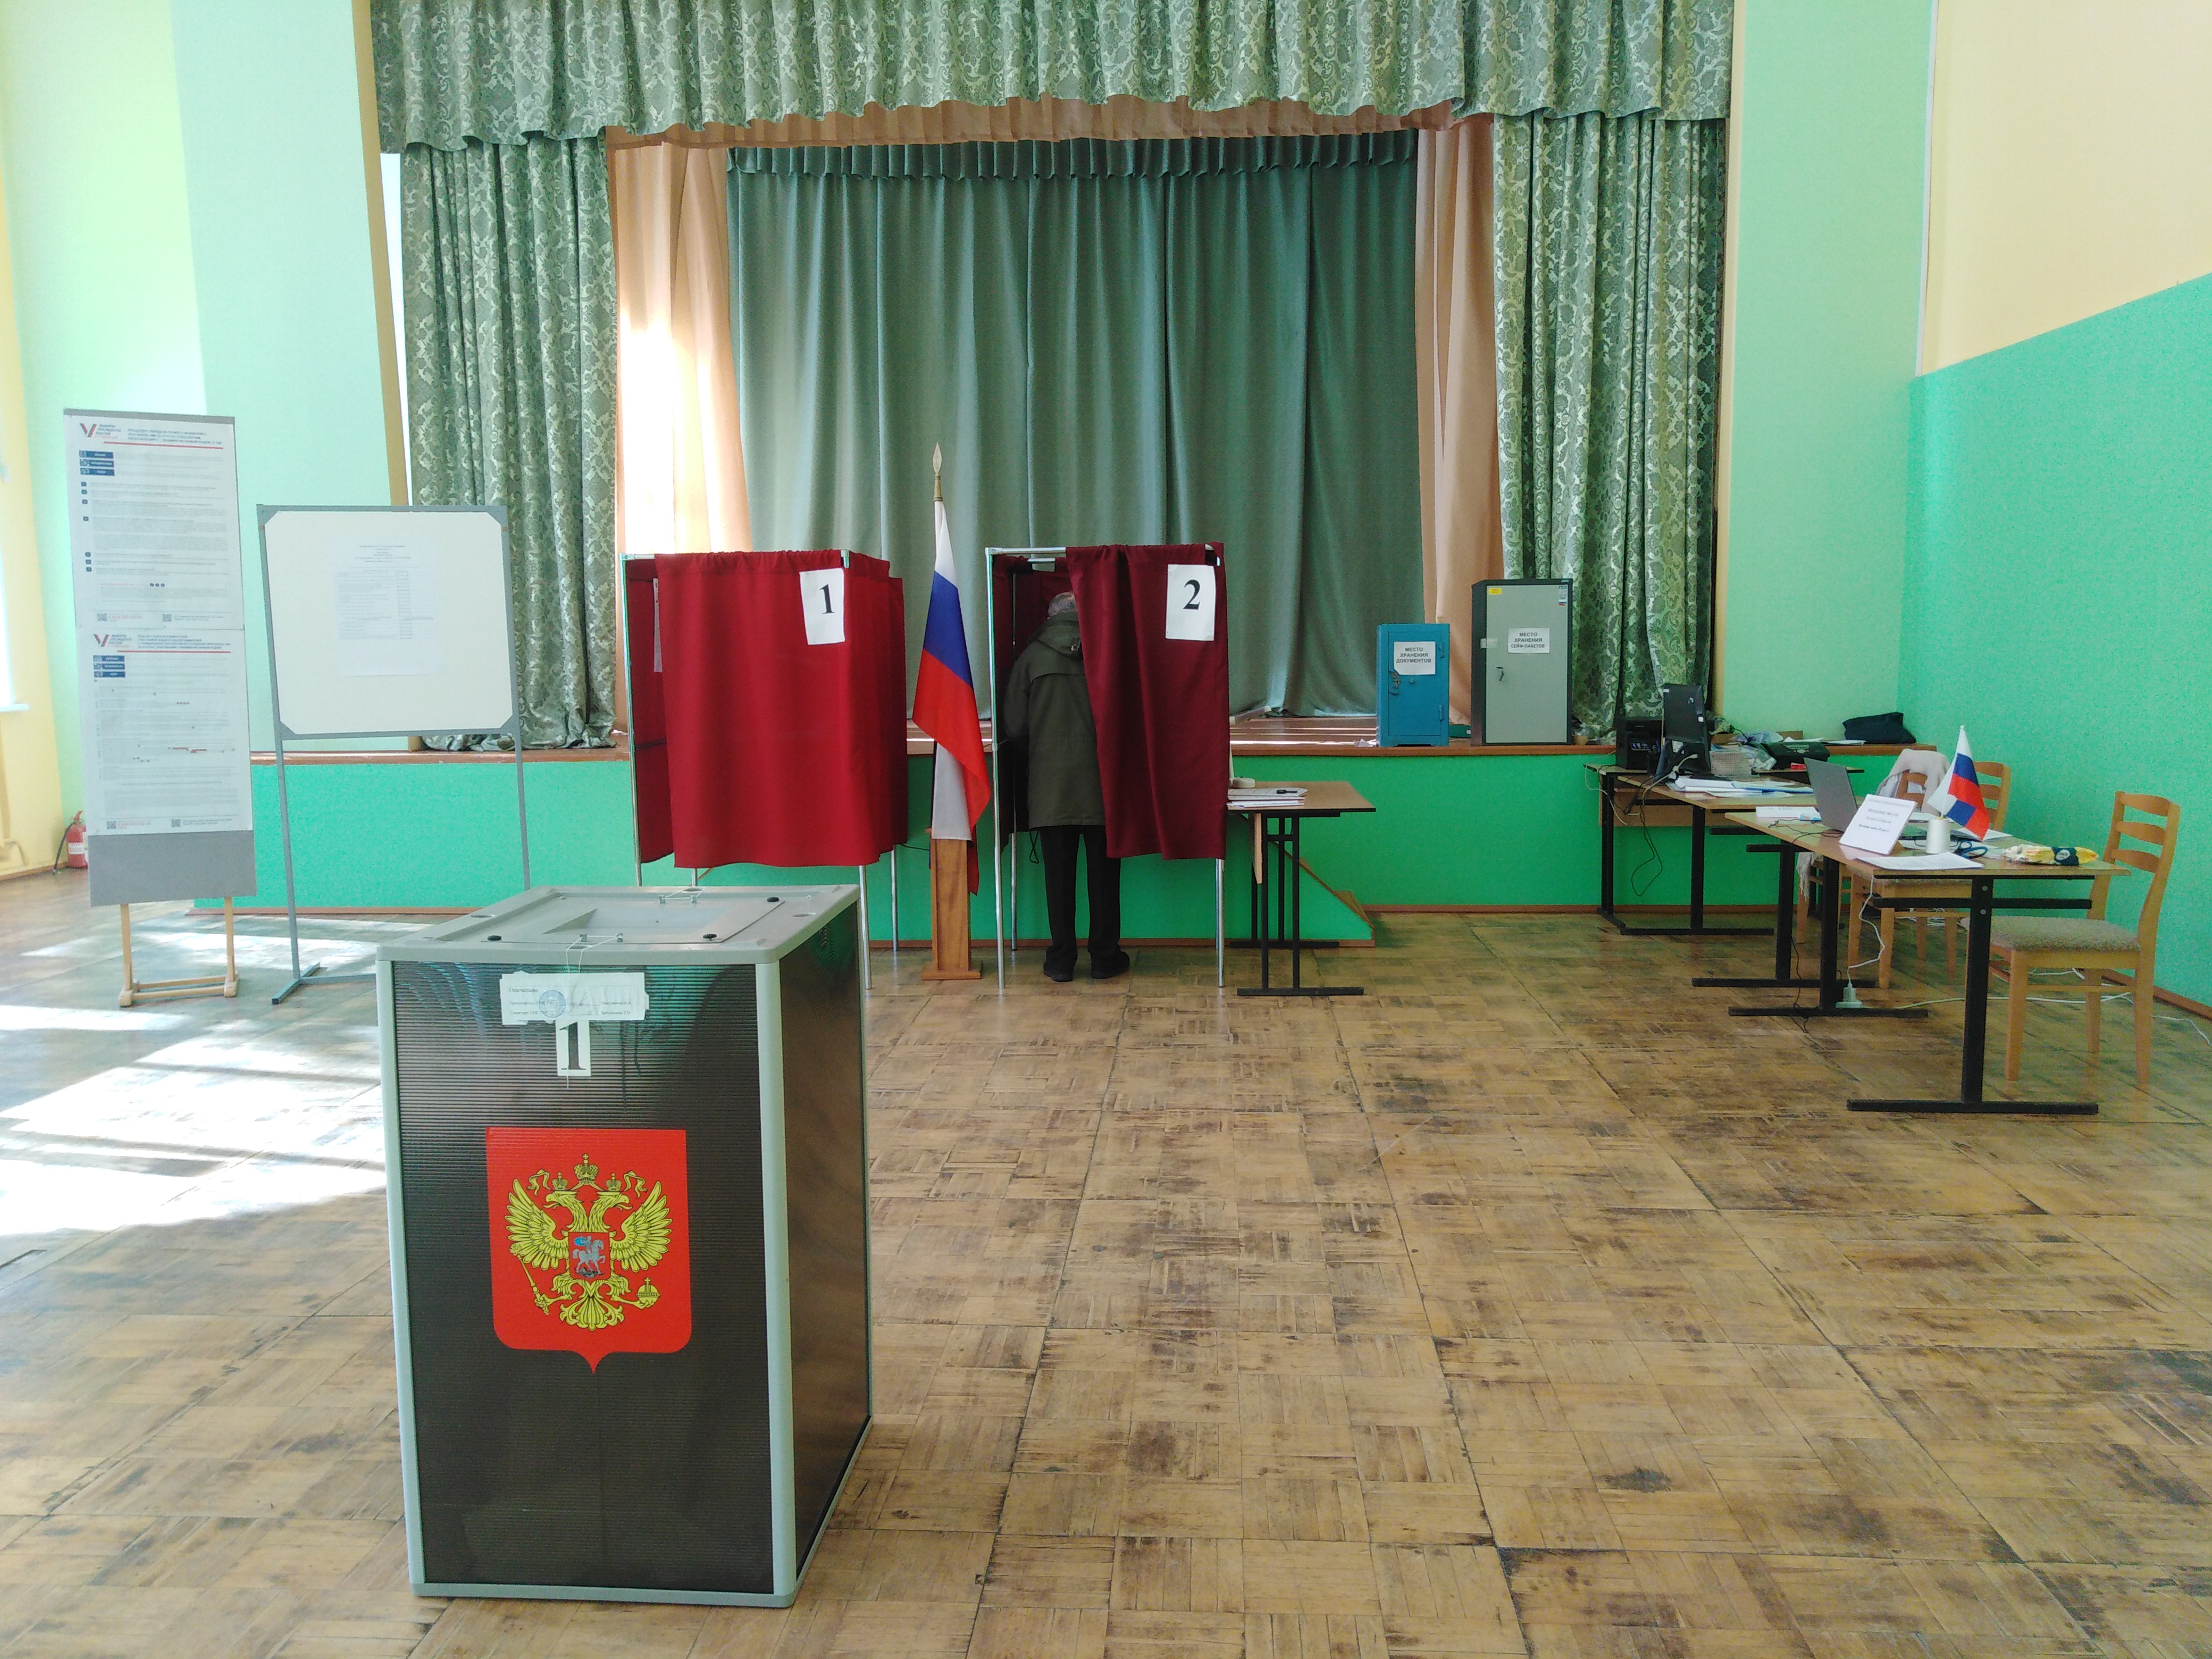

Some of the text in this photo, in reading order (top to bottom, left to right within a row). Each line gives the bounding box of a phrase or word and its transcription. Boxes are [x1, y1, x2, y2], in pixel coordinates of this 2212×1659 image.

[819, 583, 835, 615] 1
[1183, 579, 1201, 610] 2
[559, 1021, 586, 1070] 1
